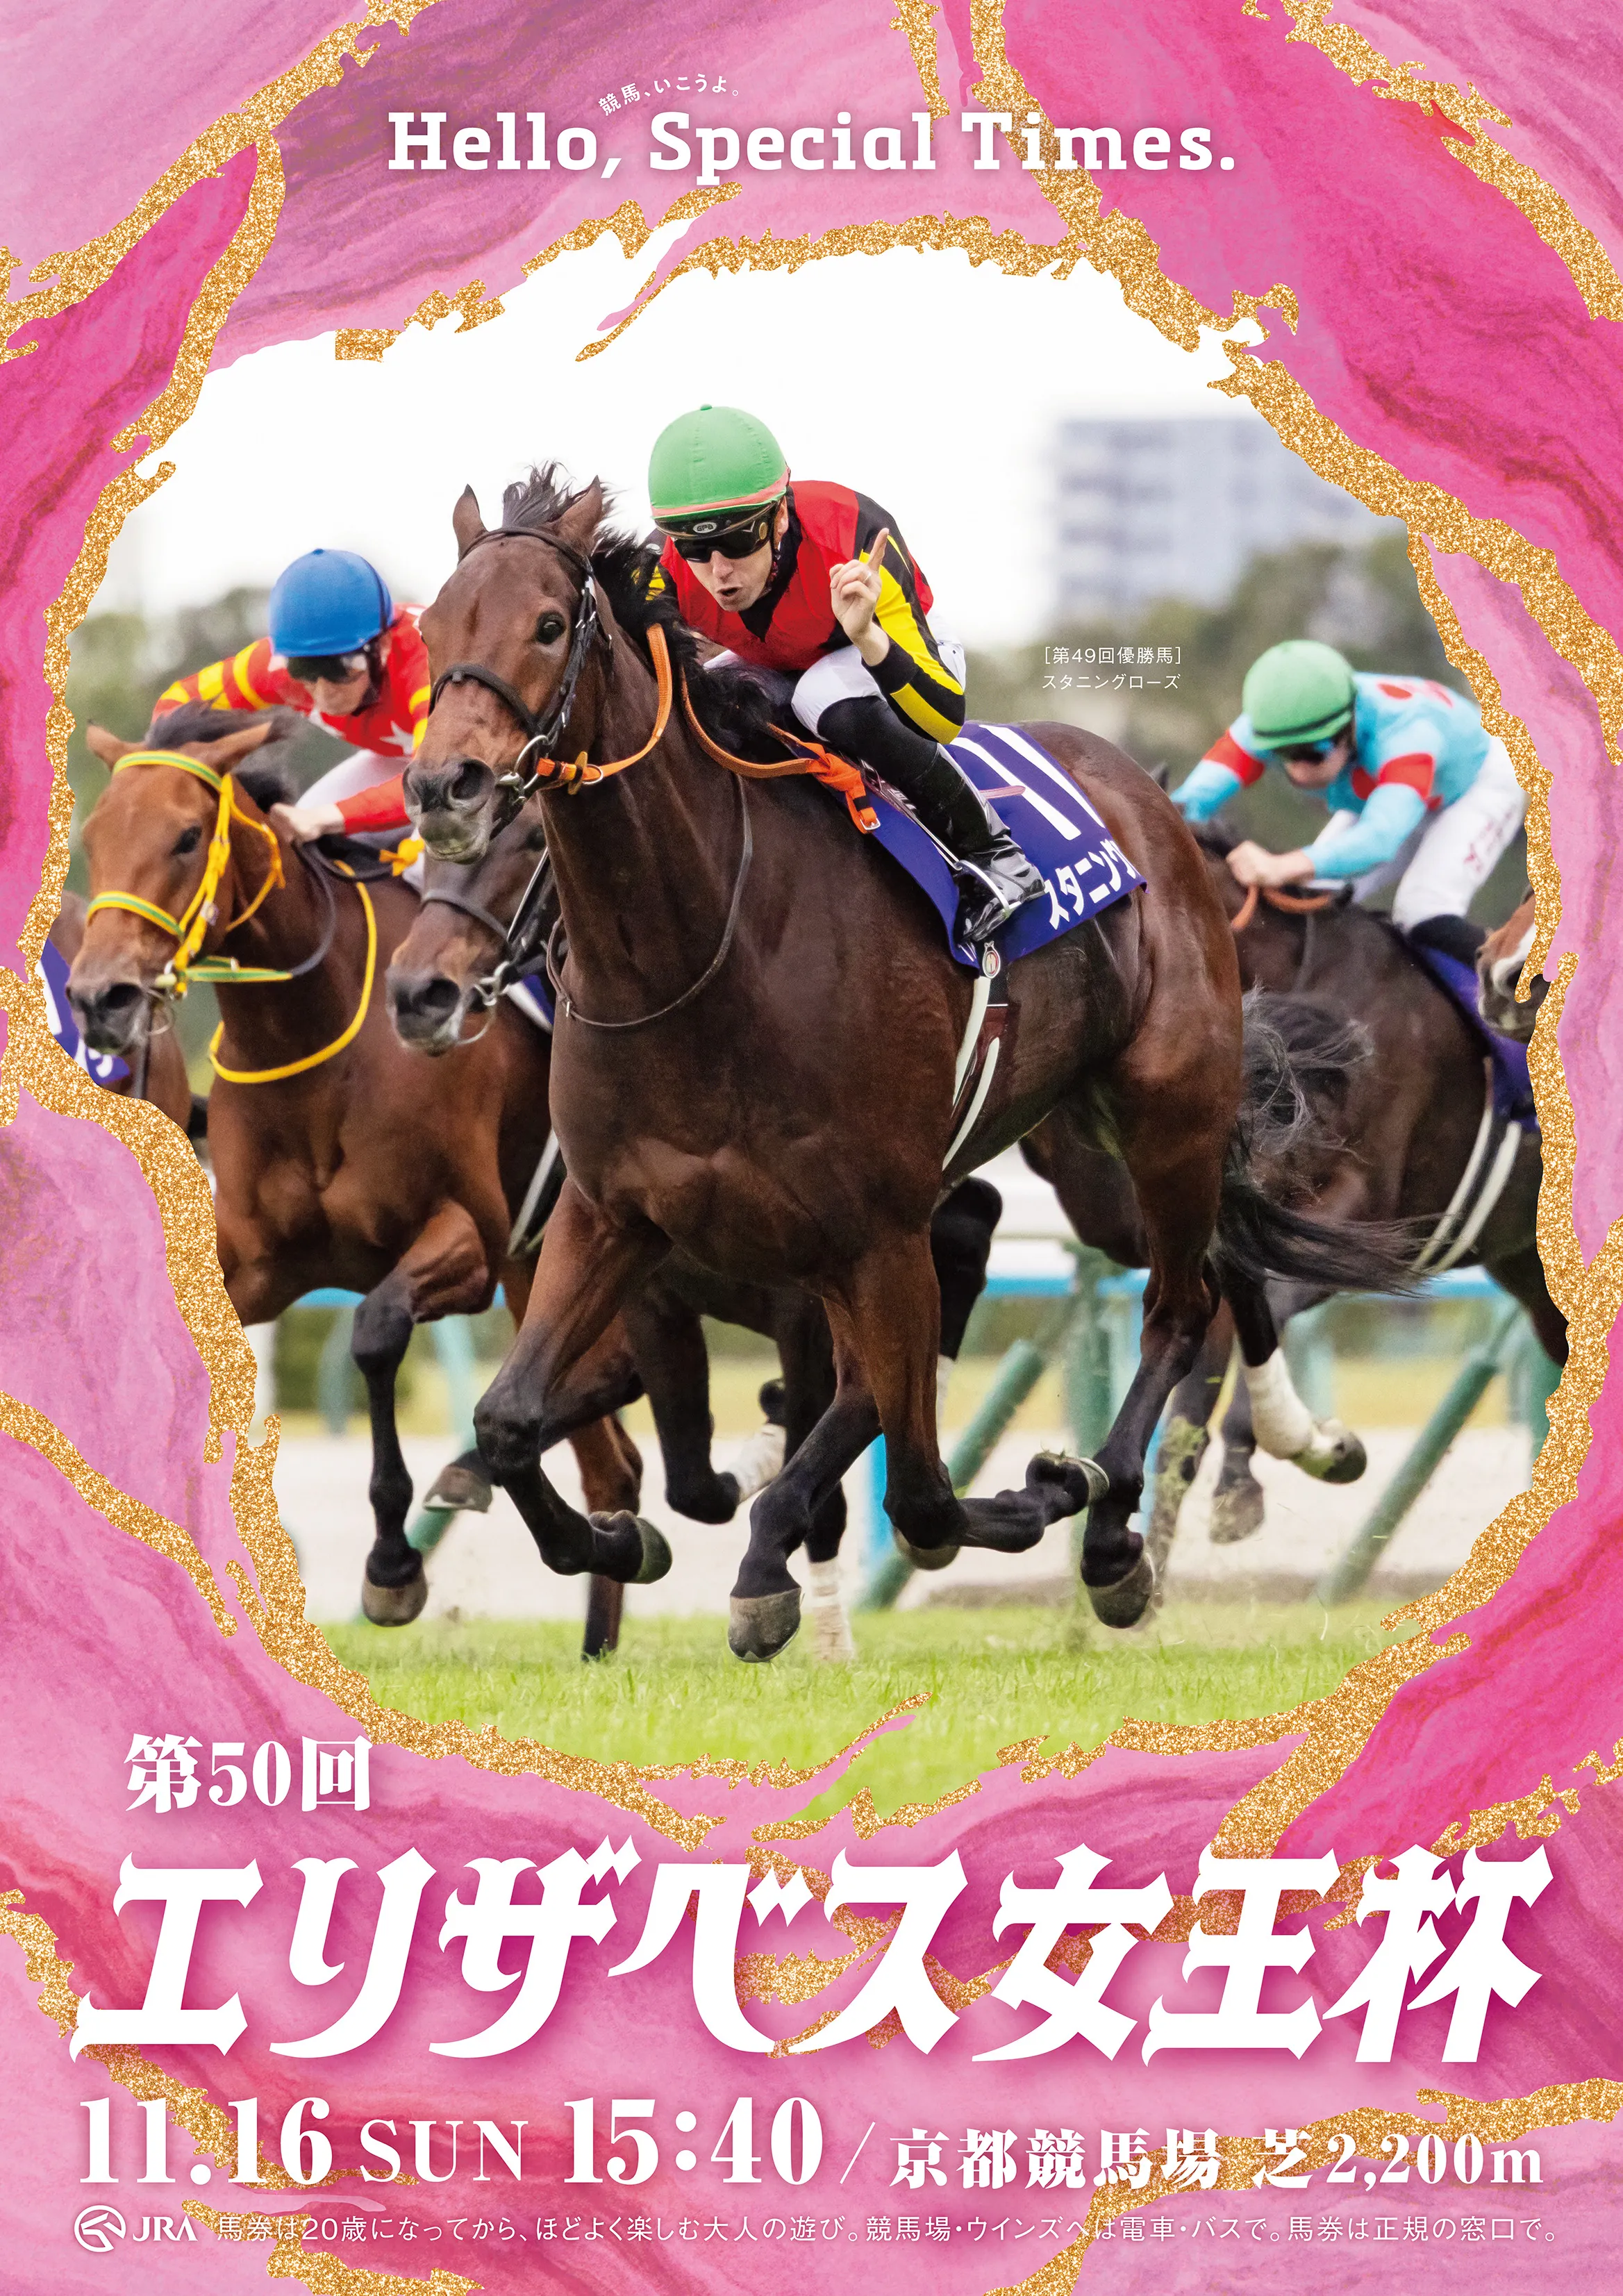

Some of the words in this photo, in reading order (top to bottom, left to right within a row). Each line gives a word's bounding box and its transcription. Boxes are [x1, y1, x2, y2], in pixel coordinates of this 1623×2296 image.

[598, 73, 739, 116] 競馬、いこうよ。
[388, 112, 622, 178] Hello,
[650, 111, 936, 185] Special
[961, 112, 1235, 170] Times.
[1042, 673, 1181, 690] スタニングローズ
[1045, 647, 1181, 665] [第49回優勝馬]
[124, 1733, 373, 1813] 第50回
[69, 1836, 1554, 2067] エリザベス女王杯
[80, 2097, 333, 2186] 11.16
[359, 2118, 528, 2183] SUN
[564, 2097, 823, 2185] 15:40
[889, 2127, 1222, 2190] 京都競馬場
[133, 2222, 199, 2243] JRA
